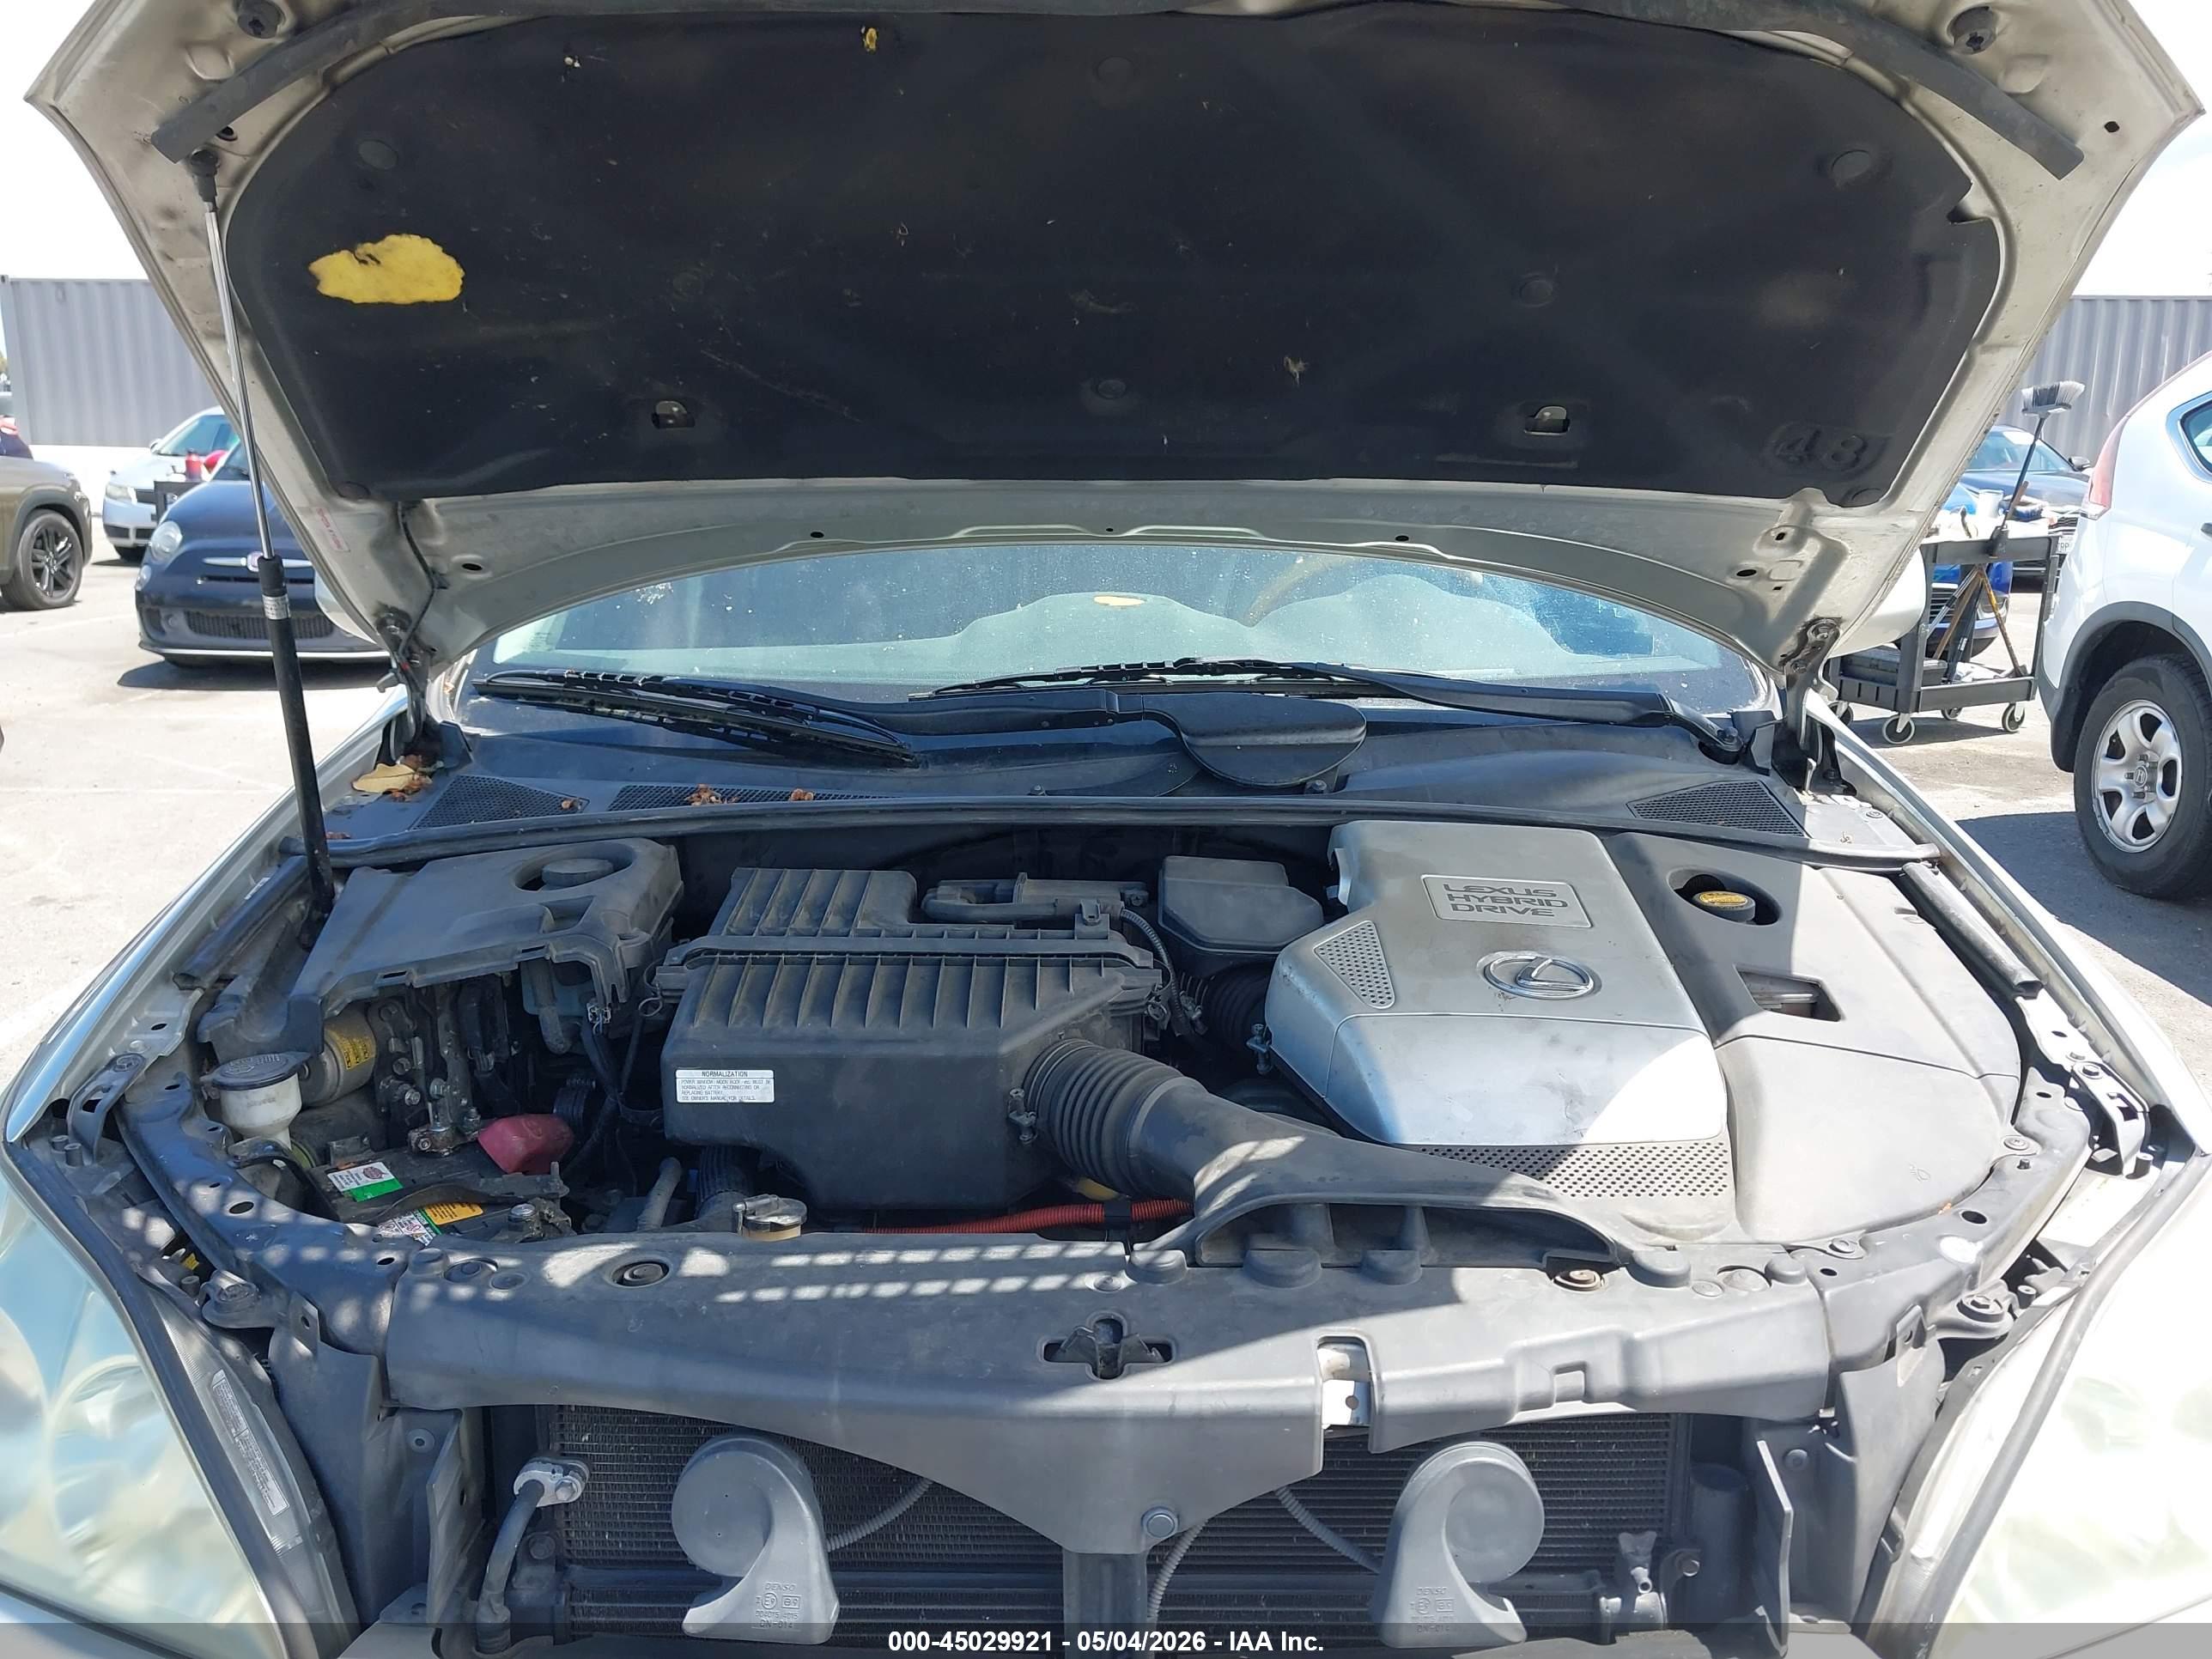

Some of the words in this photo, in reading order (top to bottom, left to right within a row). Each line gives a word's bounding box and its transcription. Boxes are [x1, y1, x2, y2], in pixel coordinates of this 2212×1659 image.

[1443, 884, 1557, 897] LEXUS
[1448, 893, 1568, 908] HYBRID
[1450, 903, 1555, 917] DRIVE
[764, 1583, 796, 1591] DENSO
